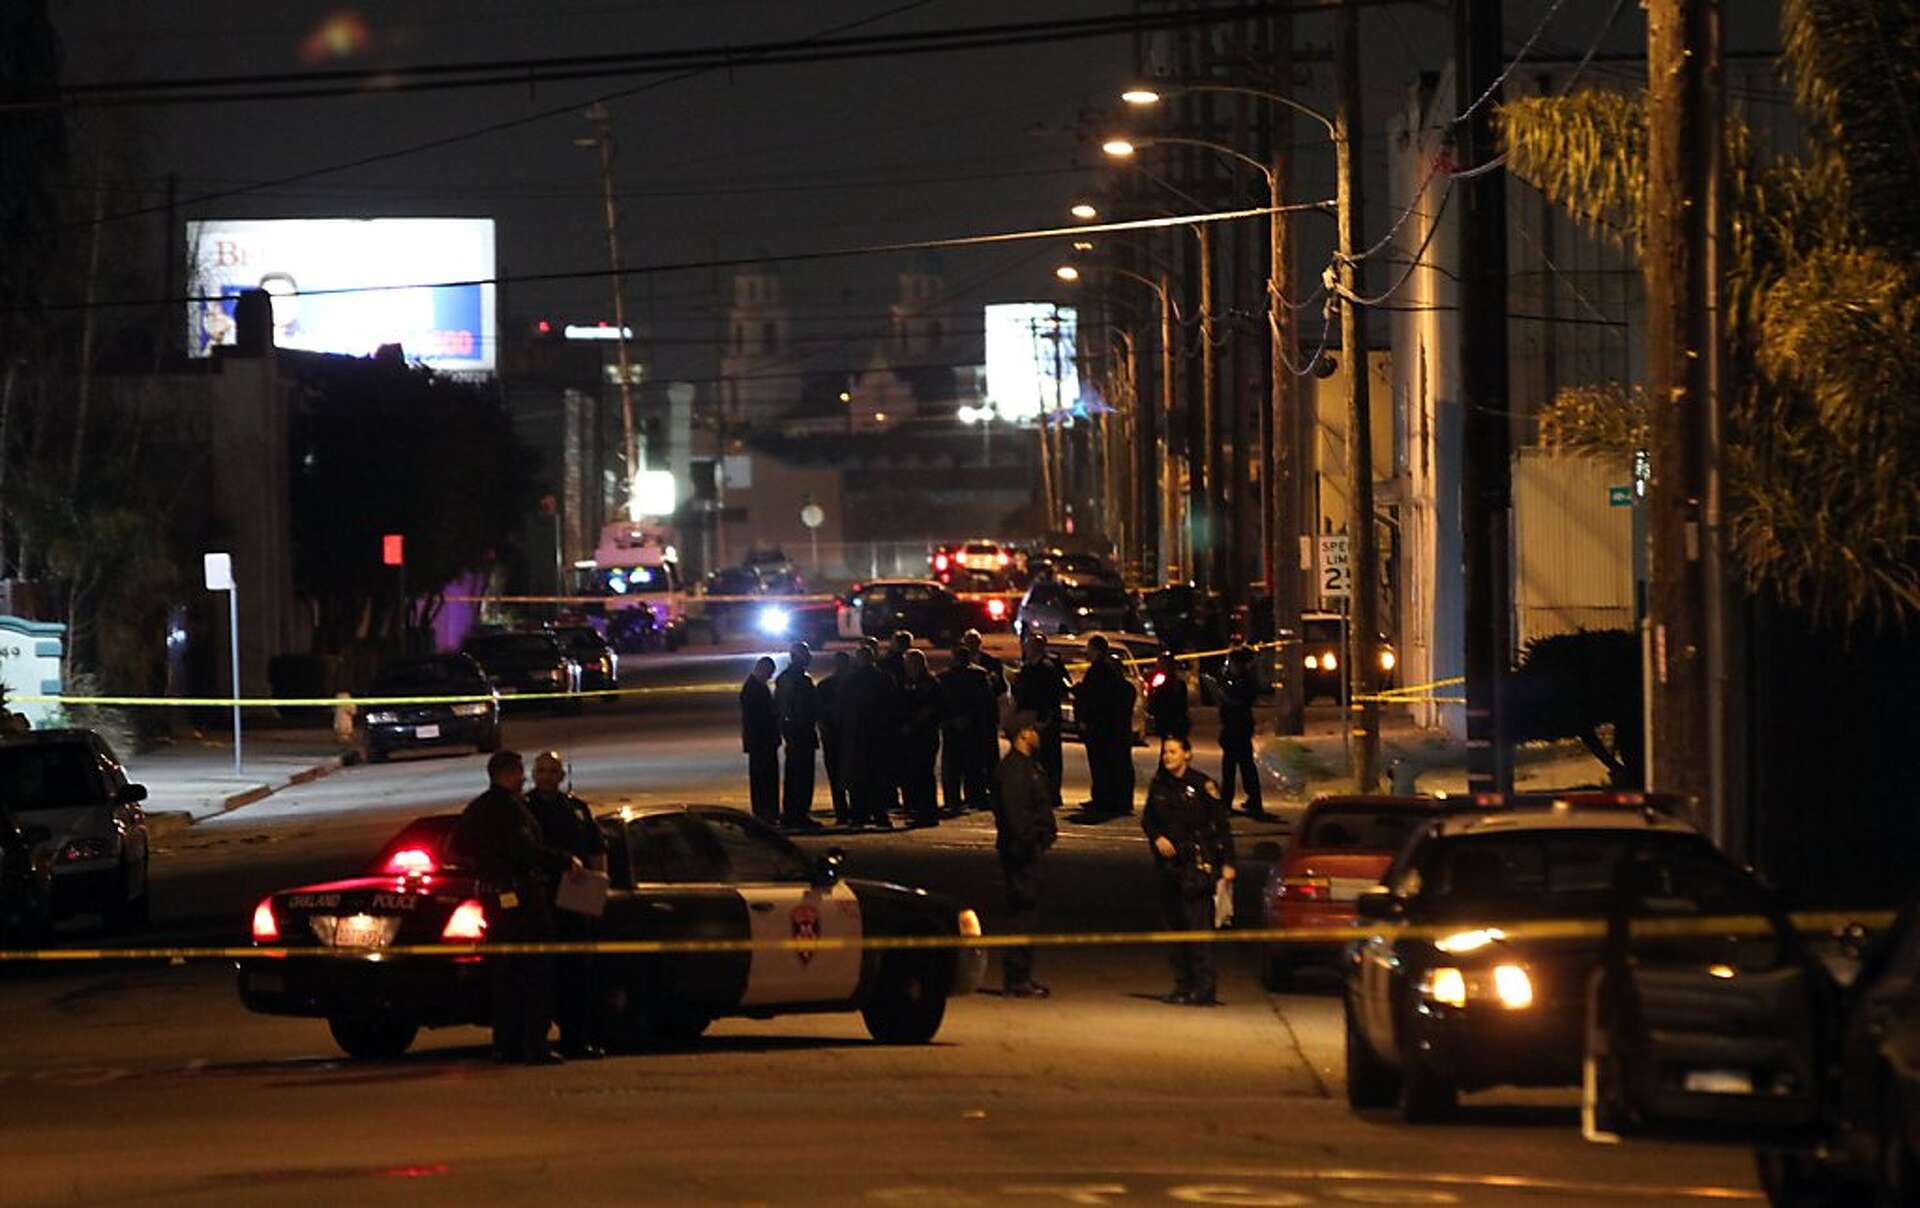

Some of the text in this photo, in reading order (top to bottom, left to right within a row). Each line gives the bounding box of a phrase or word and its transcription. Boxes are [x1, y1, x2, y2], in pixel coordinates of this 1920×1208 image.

[1321, 541, 1347, 552] SPE
[1327, 555, 1348, 565] LIM
[288, 893, 418, 911] OAKLAND POLICE
